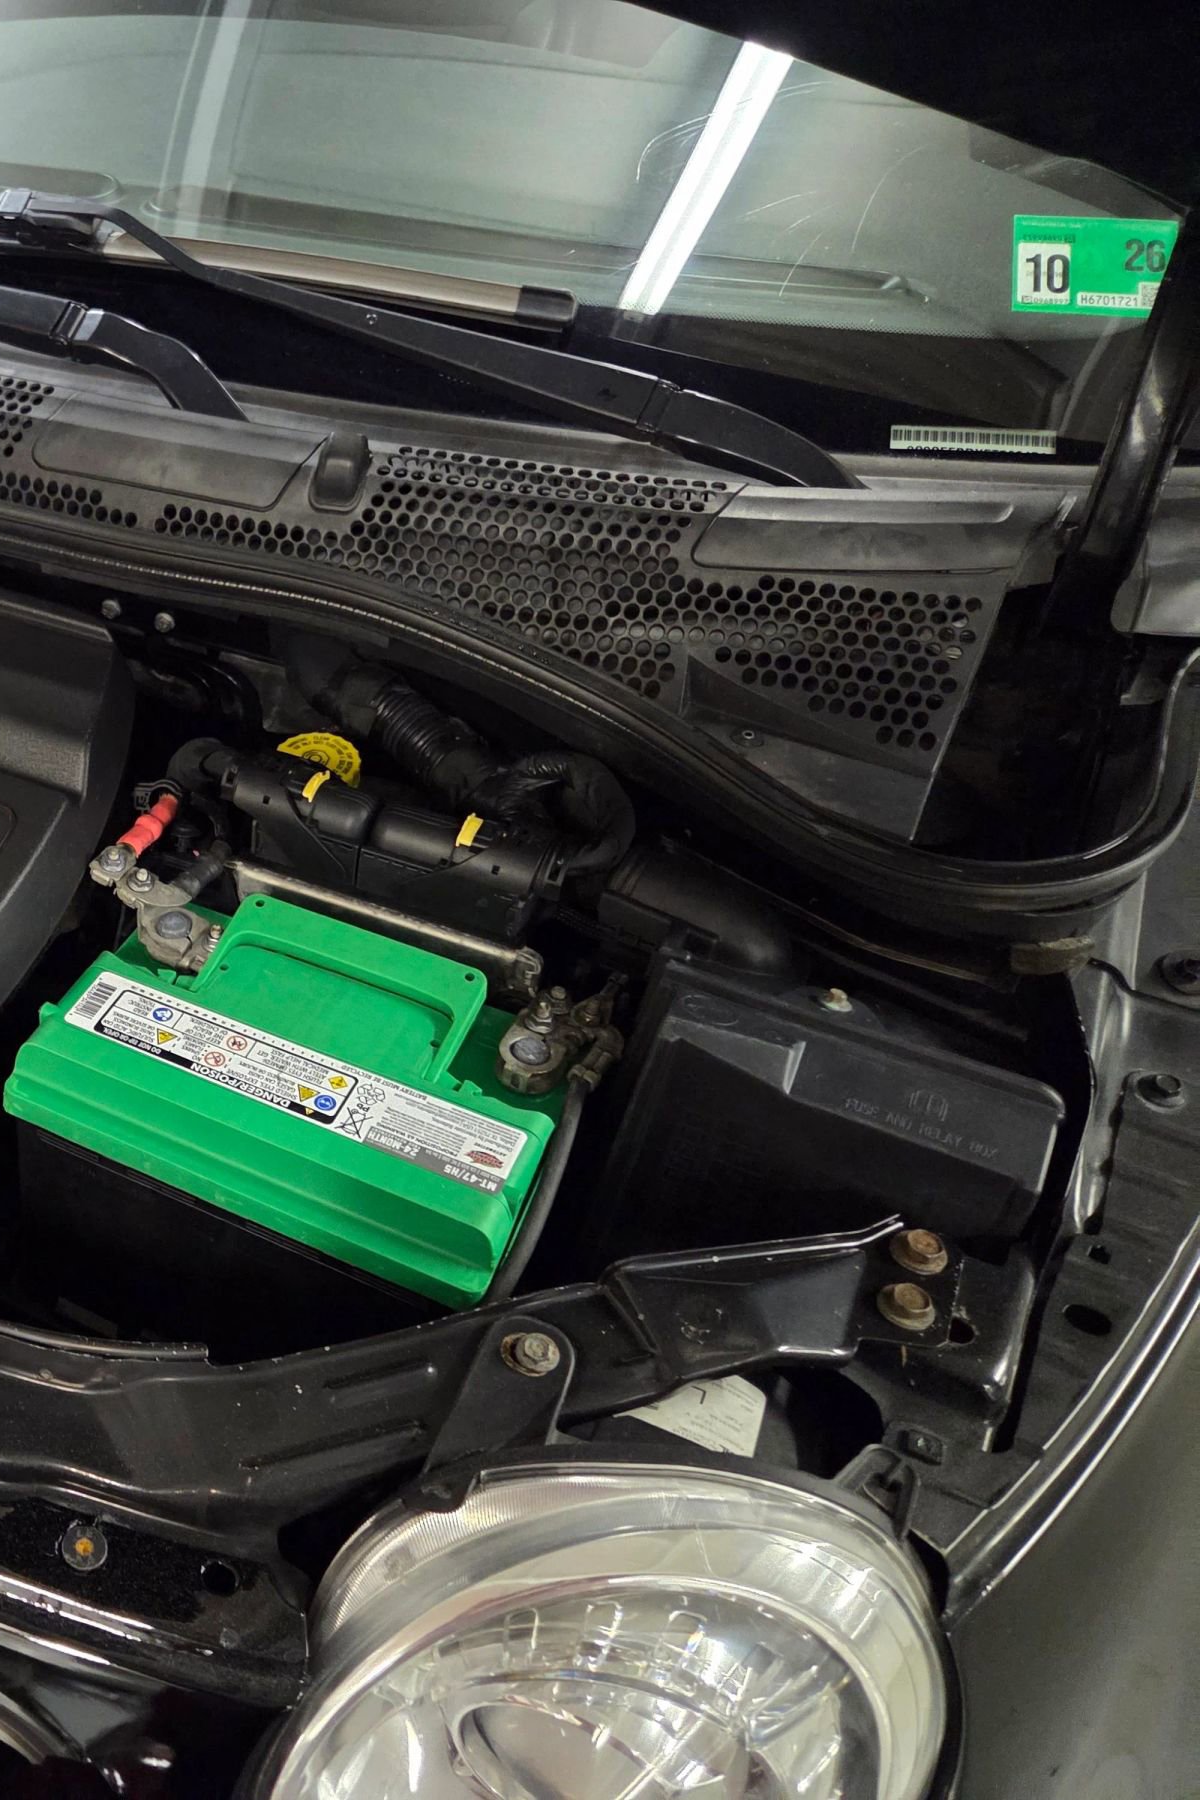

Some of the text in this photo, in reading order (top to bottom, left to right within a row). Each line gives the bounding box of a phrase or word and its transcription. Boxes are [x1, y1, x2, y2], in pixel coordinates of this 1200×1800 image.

[1124, 239, 1166, 272] 26
[1025, 253, 1070, 294] 10
[1081, 295, 1138, 306] H6701721
[132, 1007, 149, 1016] READ
[102, 1018, 155, 1042] SULFURIC ACID CAN
[138, 1027, 155, 1036] CAUSE
[192, 1024, 225, 1040] THE REACH
[118, 1033, 130, 1041] OR
[127, 1037, 139, 1045] TIP
[205, 1035, 221, 1044] KEEP
[137, 1041, 152, 1050] NOT
[150, 1046, 162, 1054] DO
[256, 1049, 269, 1057] GET
[285, 1054, 302, 1064] HELP
[290, 1062, 308, 1073] WITH
[301, 1060, 329, 1074] MEDICAL
[340, 1064, 372, 1079] RECYCLED
[225, 1068, 258, 1084] EXPLOSIVE
[247, 1070, 265, 1080] CAUSE
[263, 1076, 276, 1084] CAN
[302, 1073, 323, 1084] FLUSH
[189, 1062, 291, 1107] DANGER/POISON
[381, 1080, 400, 1090] MUST
[274, 1087, 297, 1100] SHIELD
[400, 1087, 427, 1100] BATTERY
[354, 1102, 370, 1112] Pb
[844, 1097, 880, 1116] FUSE
[885, 1112, 913, 1131] AND
[375, 1122, 405, 1136] WARNING
[367, 1130, 419, 1156] 24-MONTH
[414, 1137, 457, 1157] PROPOSITION
[442, 1163, 497, 1191] MT-47/H5
